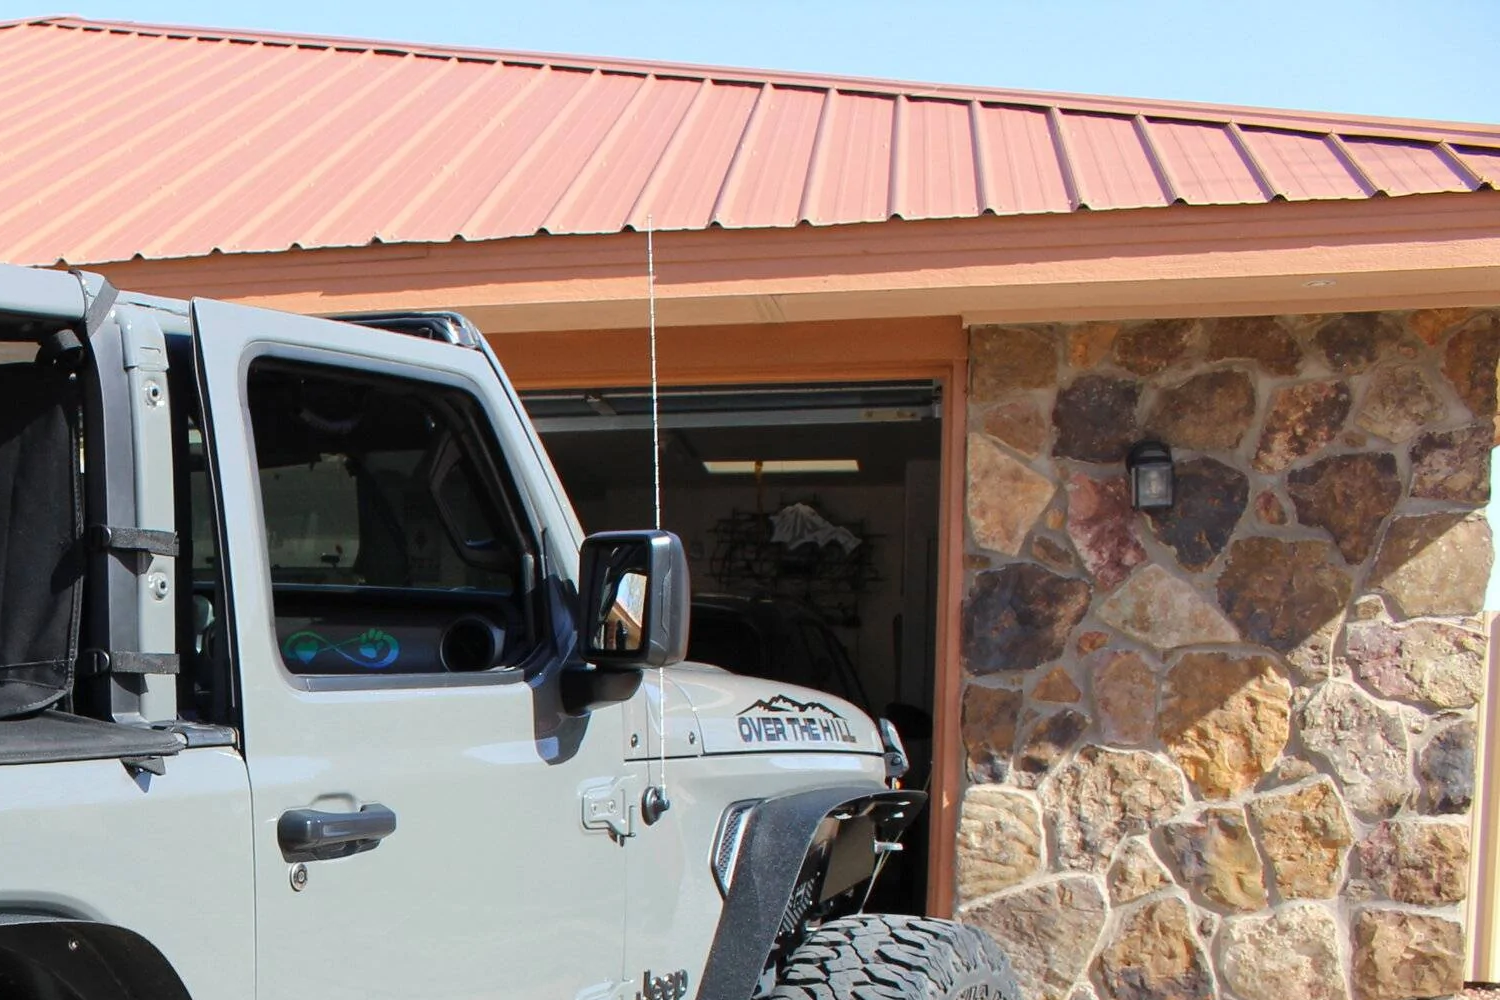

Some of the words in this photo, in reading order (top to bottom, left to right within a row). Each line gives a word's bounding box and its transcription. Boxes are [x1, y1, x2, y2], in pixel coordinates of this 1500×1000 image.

[738, 716, 787, 743] OVER
[786, 716, 821, 742] THE
[819, 717, 857, 744] HILL
